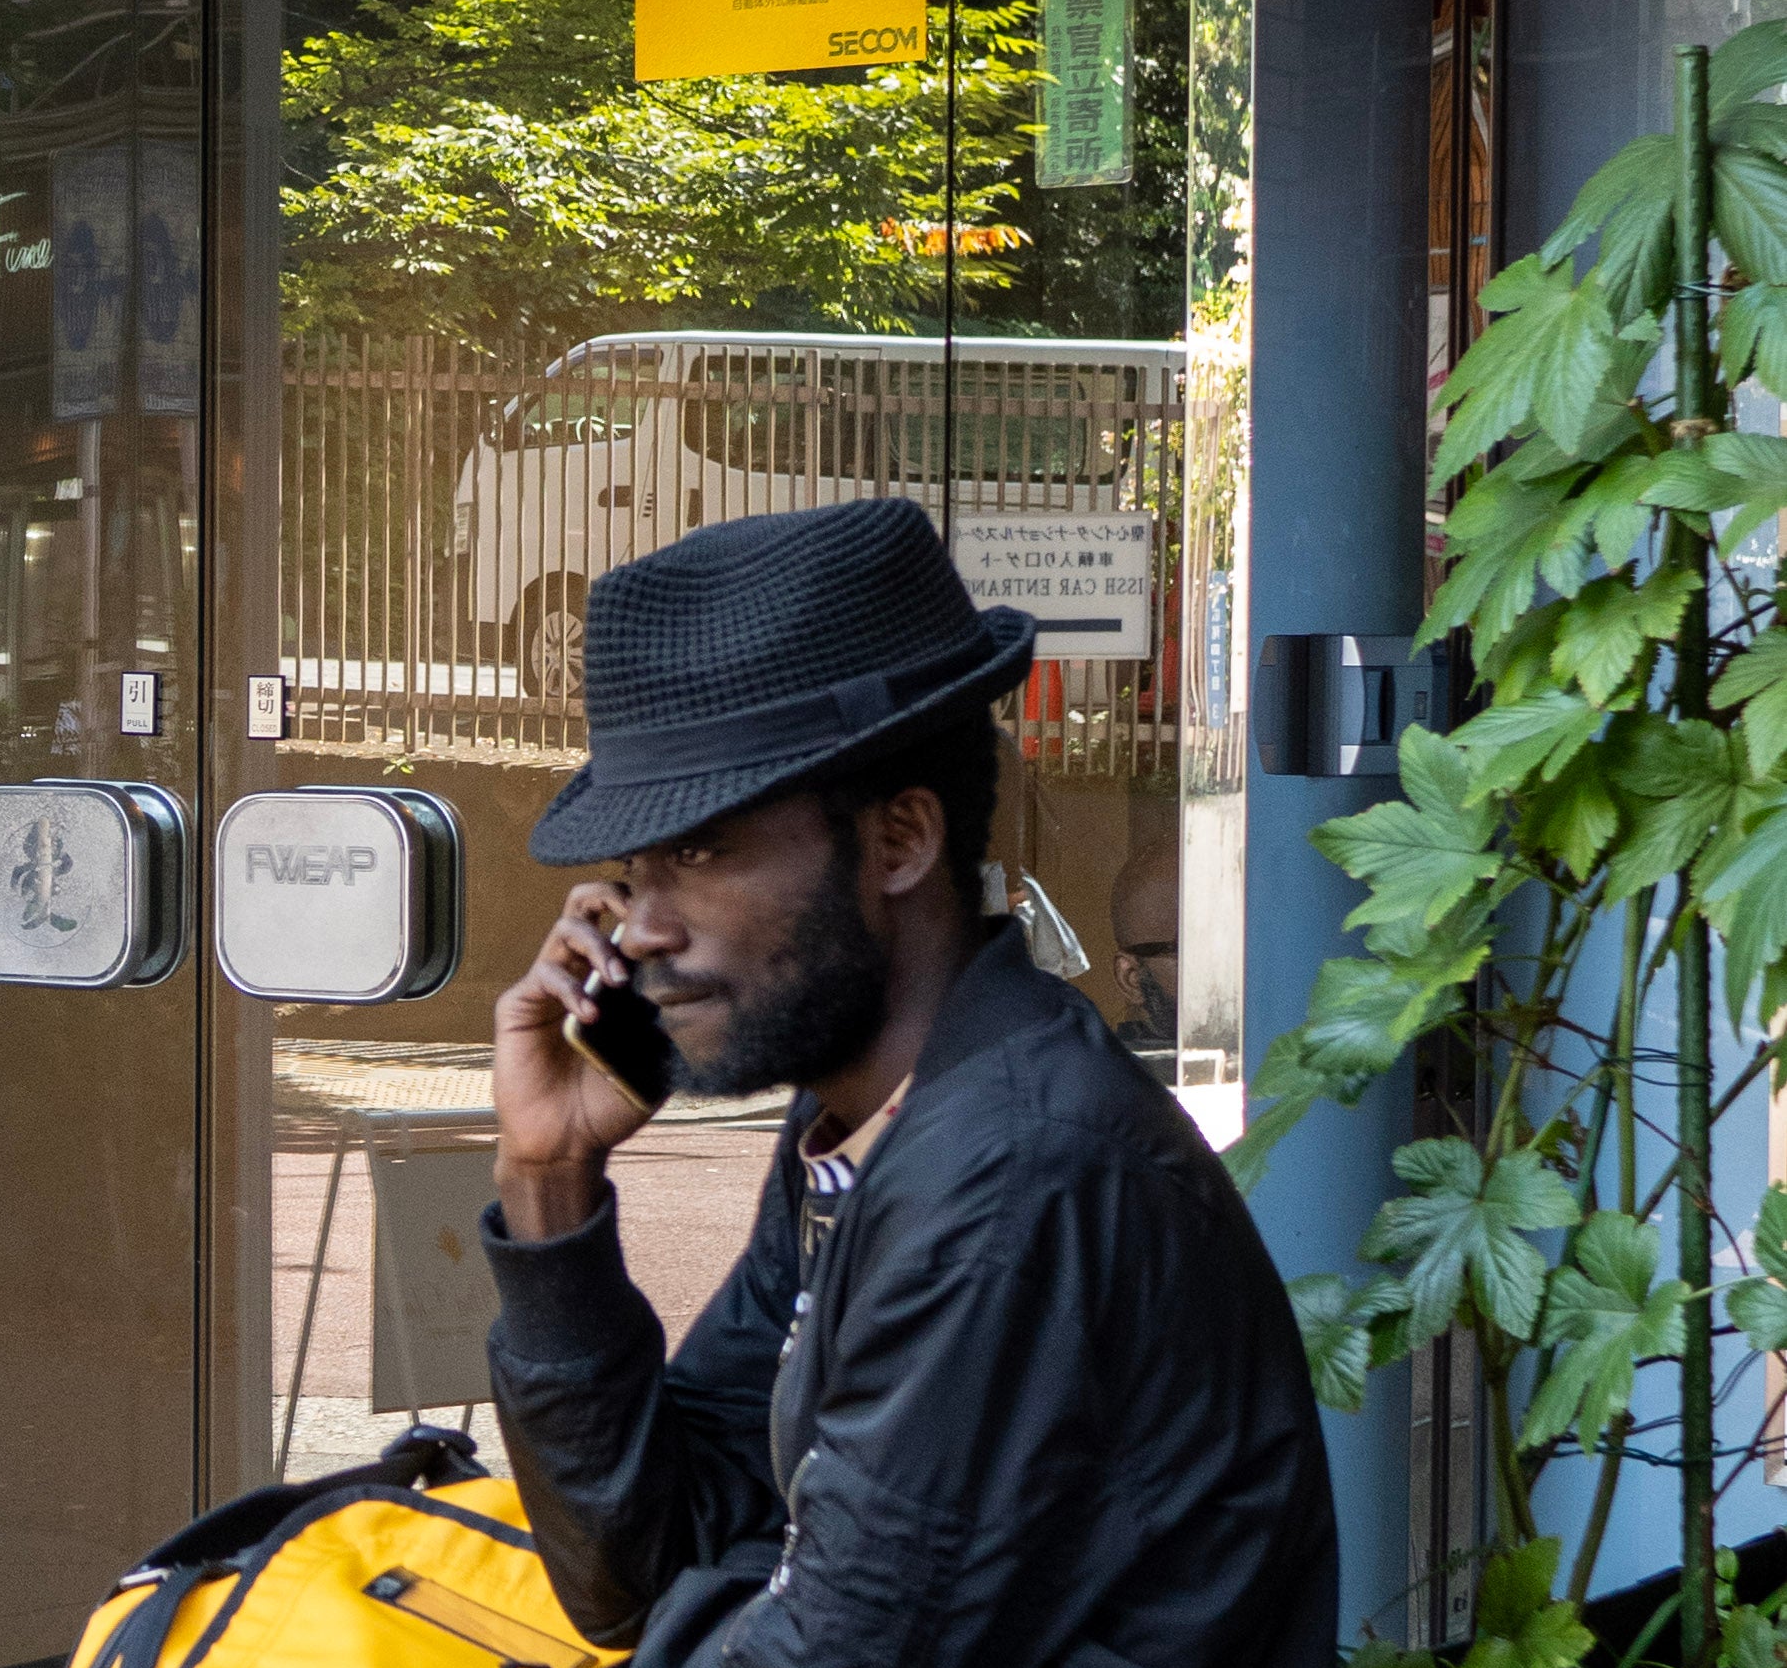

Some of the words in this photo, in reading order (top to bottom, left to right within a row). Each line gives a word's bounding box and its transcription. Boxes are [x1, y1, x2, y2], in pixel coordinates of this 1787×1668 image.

[828, 26, 918, 57] SECOM
[128, 680, 146, 703] 引
[256, 682, 275, 715] 締切
[126, 719, 148, 728] PULL
[251, 723, 278, 733] CLOSED
[245, 842, 378, 887] FWEAP
